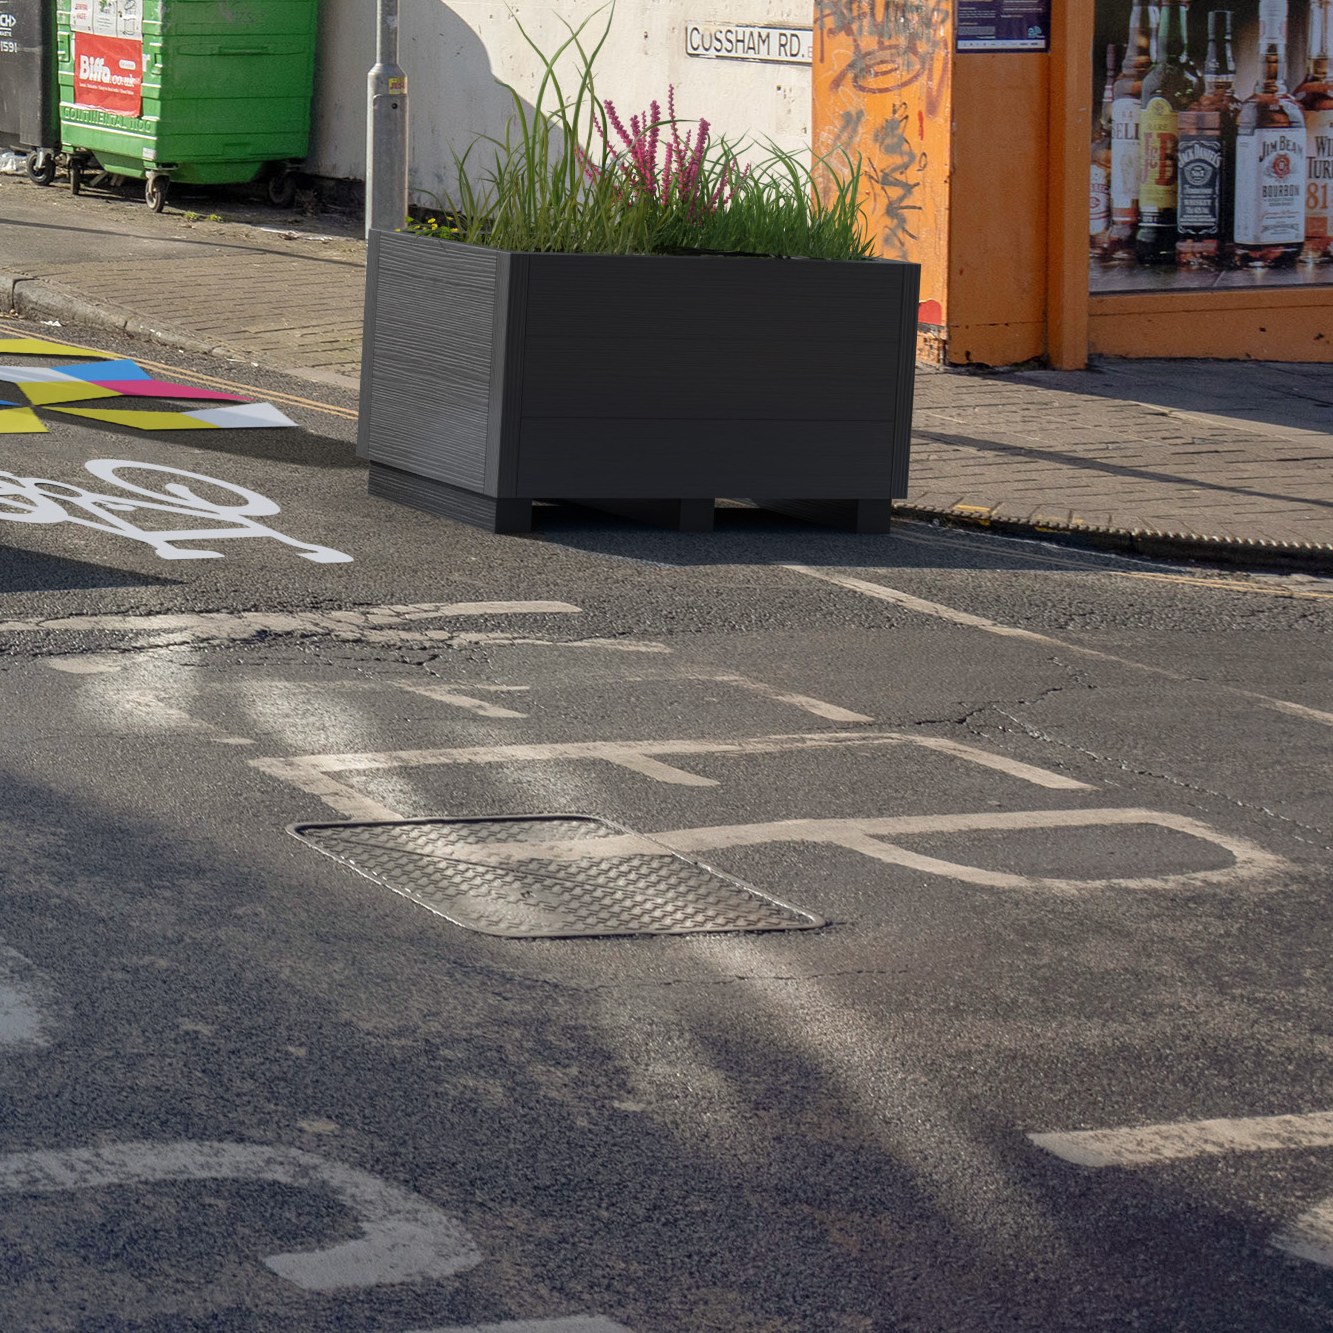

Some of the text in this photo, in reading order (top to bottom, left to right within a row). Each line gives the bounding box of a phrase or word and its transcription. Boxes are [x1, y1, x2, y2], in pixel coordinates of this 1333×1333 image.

[690, 27, 770, 55] COSSHAM
[778, 32, 805, 58] RD.
[79, 54, 135, 88] Biffa.co.uk
[63, 107, 127, 128] CONTINENTAL
[1259, 136, 1303, 162] JIM BEAM
[1262, 185, 1299, 197] BOURBON
[1306, 183, 1328, 209] 81
